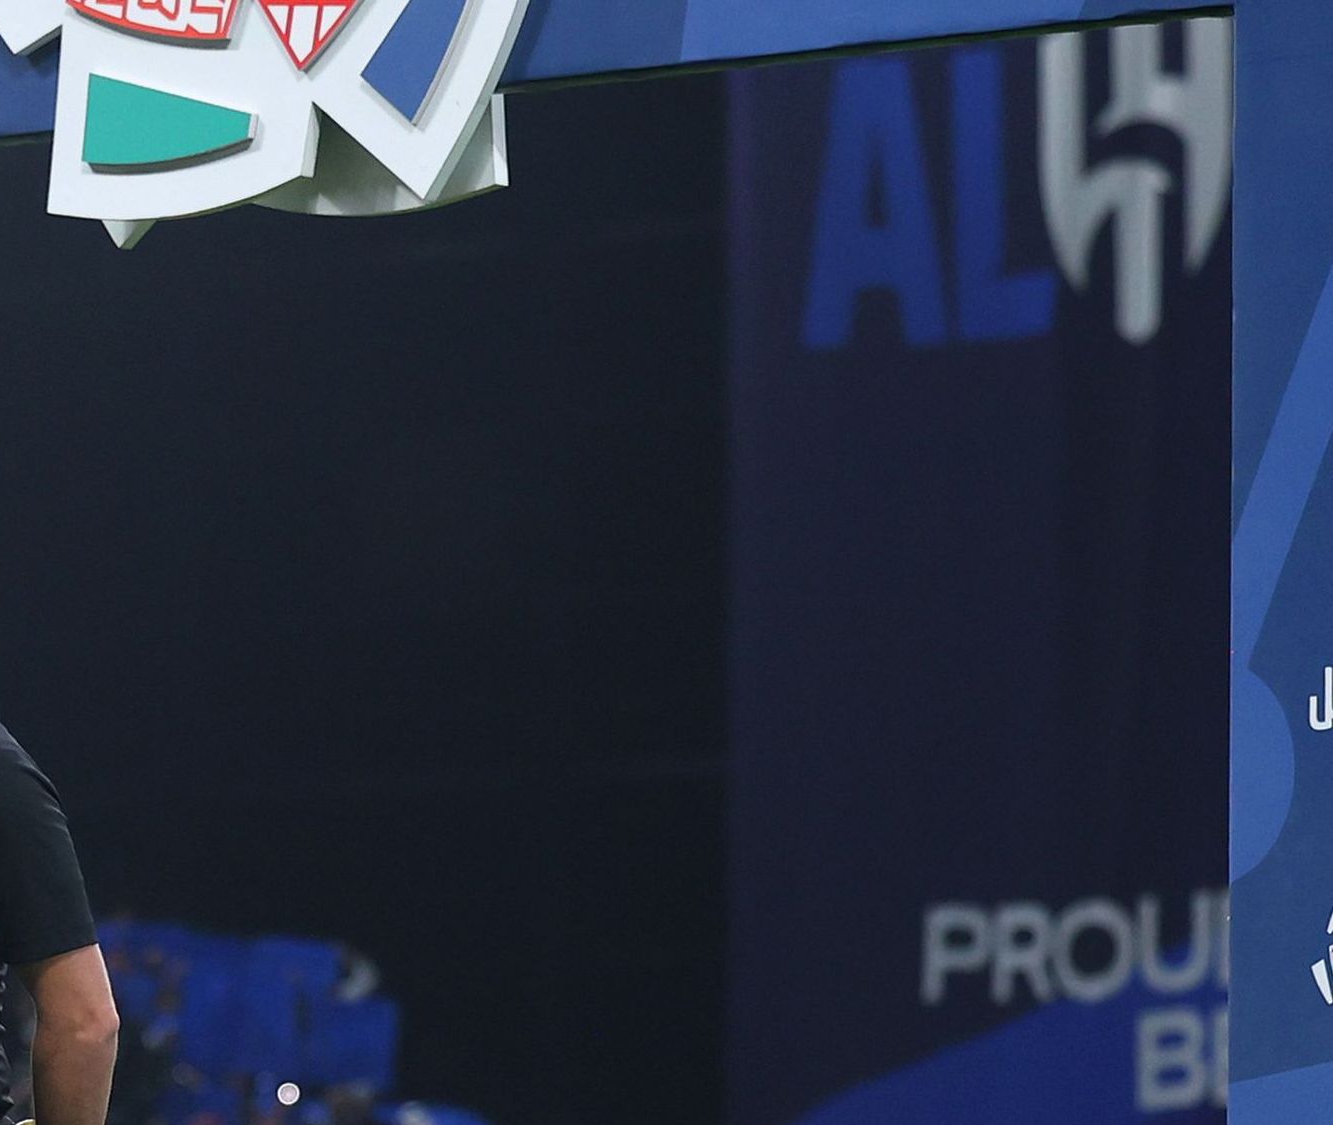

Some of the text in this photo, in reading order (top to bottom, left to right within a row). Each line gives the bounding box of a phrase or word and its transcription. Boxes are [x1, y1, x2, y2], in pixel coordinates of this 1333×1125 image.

[801, 49, 1057, 349] AL
[920, 888, 1228, 1006] PROU
[1138, 1009, 1228, 1112] B
